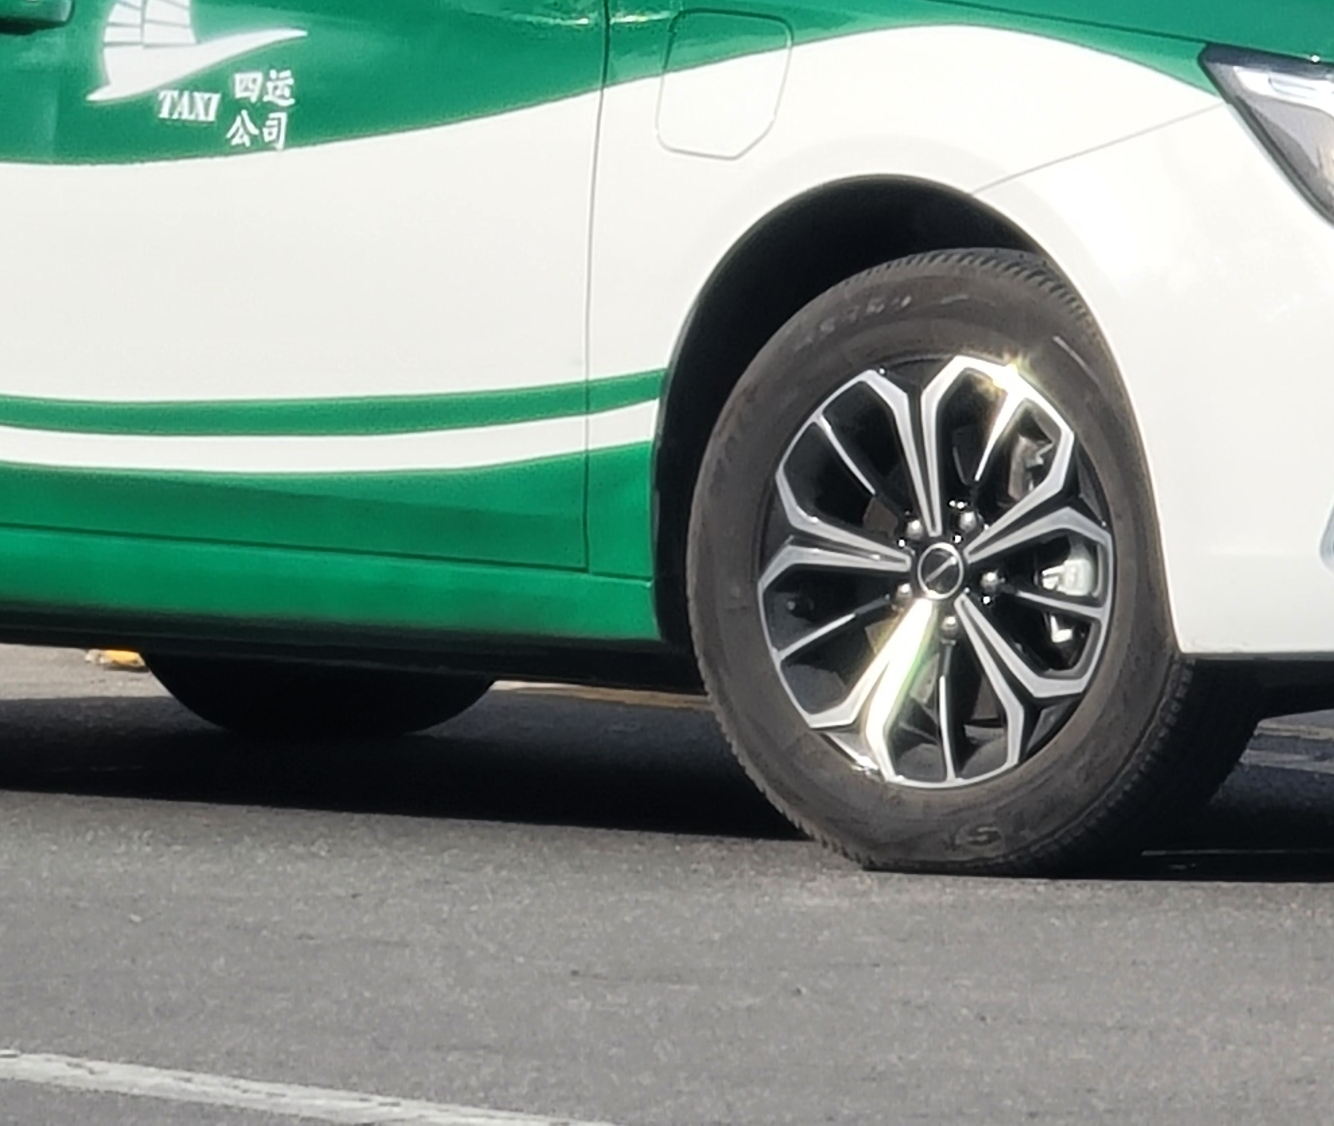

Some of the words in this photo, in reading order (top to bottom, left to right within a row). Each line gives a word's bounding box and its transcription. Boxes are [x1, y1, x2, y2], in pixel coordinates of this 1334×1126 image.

[158, 90, 221, 122] TAXI
[234, 69, 295, 106] 四运
[226, 109, 288, 151] 公司
